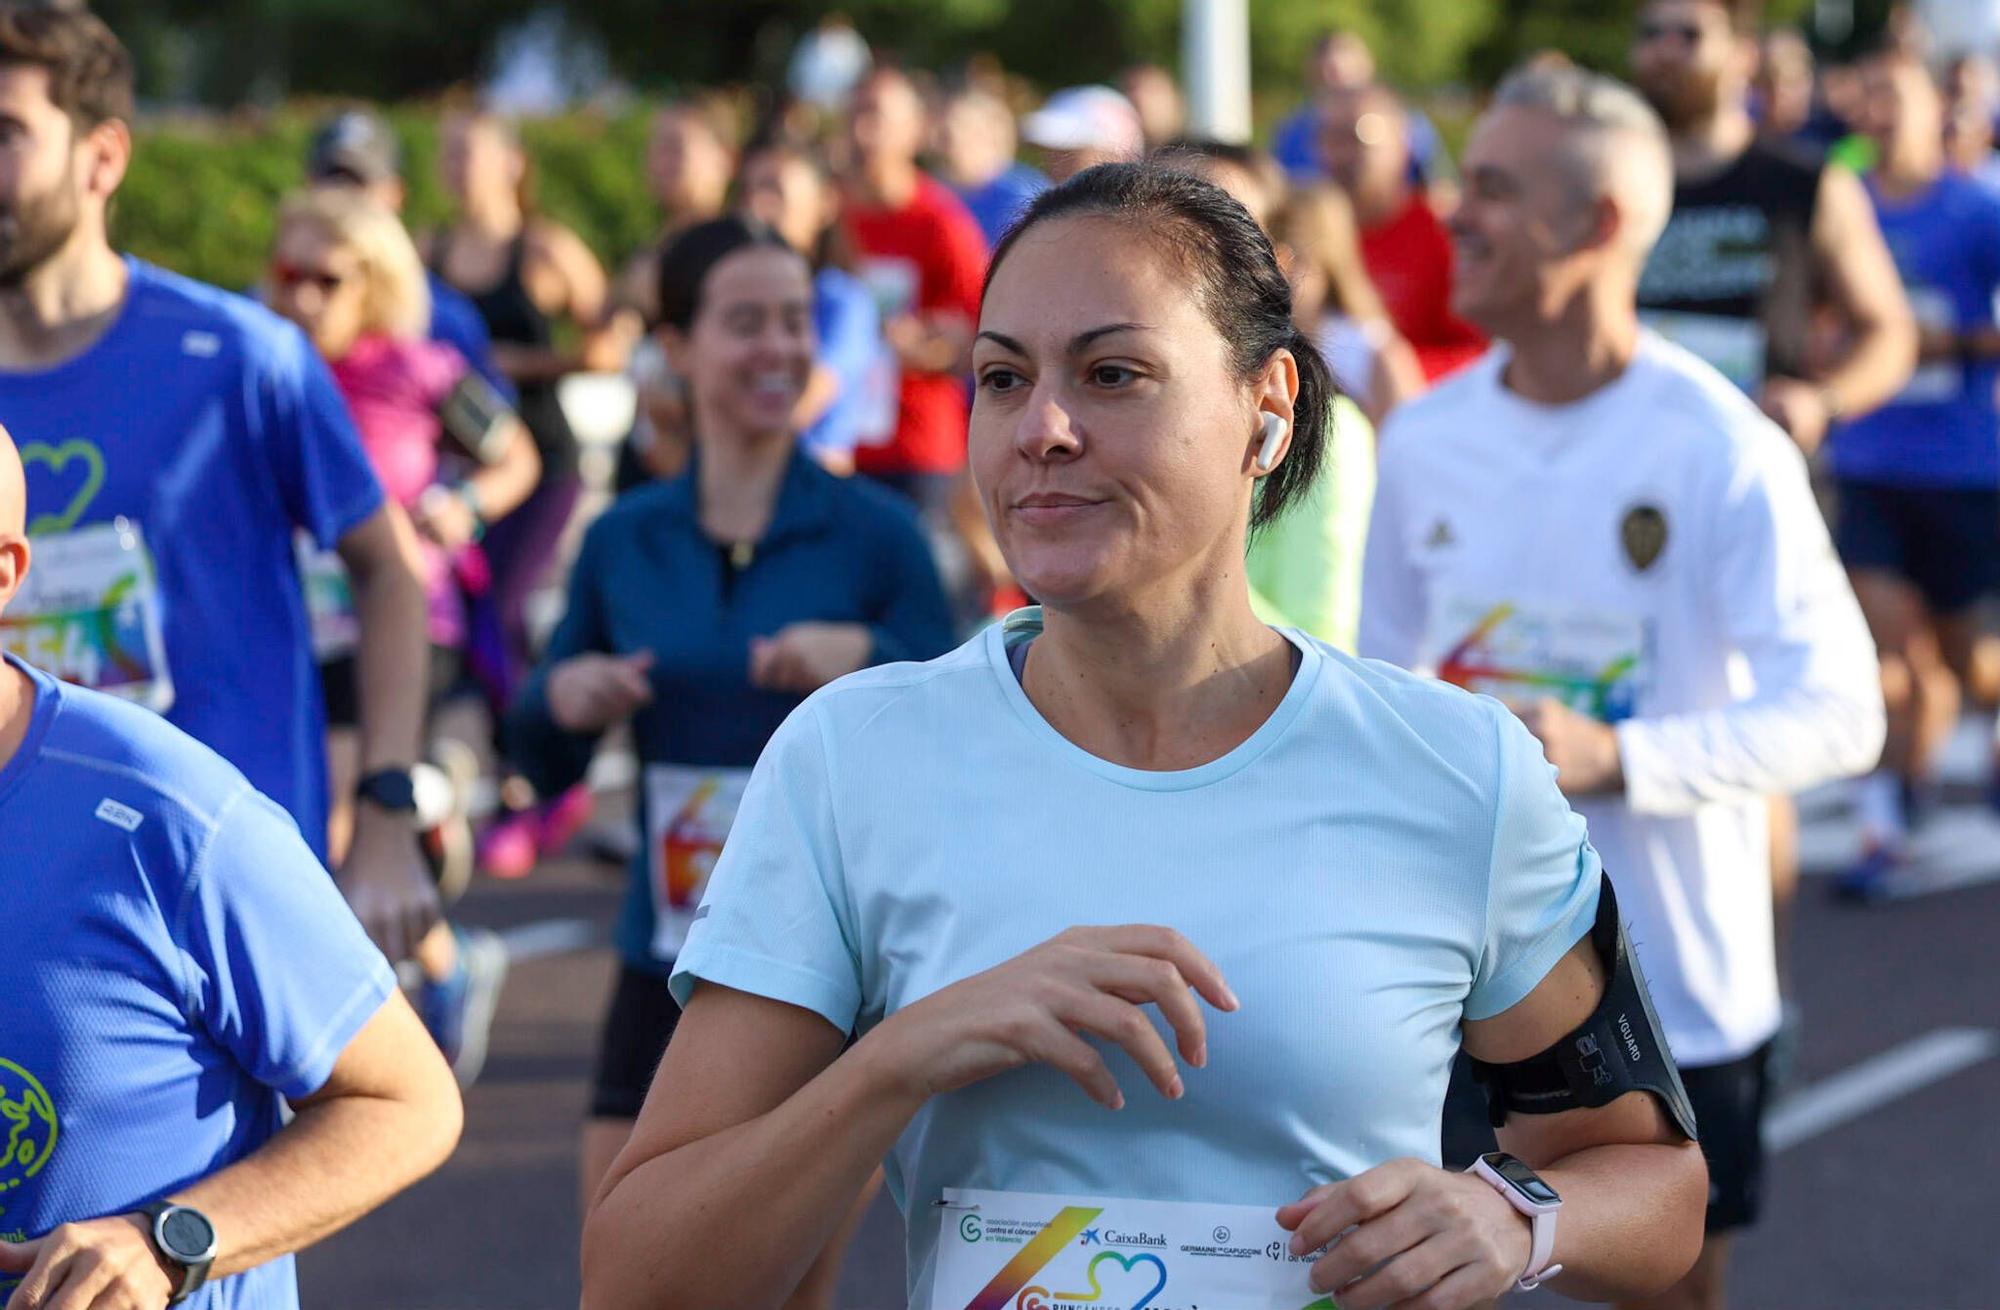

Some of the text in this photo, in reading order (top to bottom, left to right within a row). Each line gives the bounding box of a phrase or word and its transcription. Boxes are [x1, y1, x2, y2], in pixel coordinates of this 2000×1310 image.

[1618, 1013, 1641, 1062] VGUARD
[1104, 1229, 1167, 1246] CaixaBank
[1180, 1244, 1217, 1253] GERMAINE
[1223, 1246, 1262, 1256] CAPUCCINI
